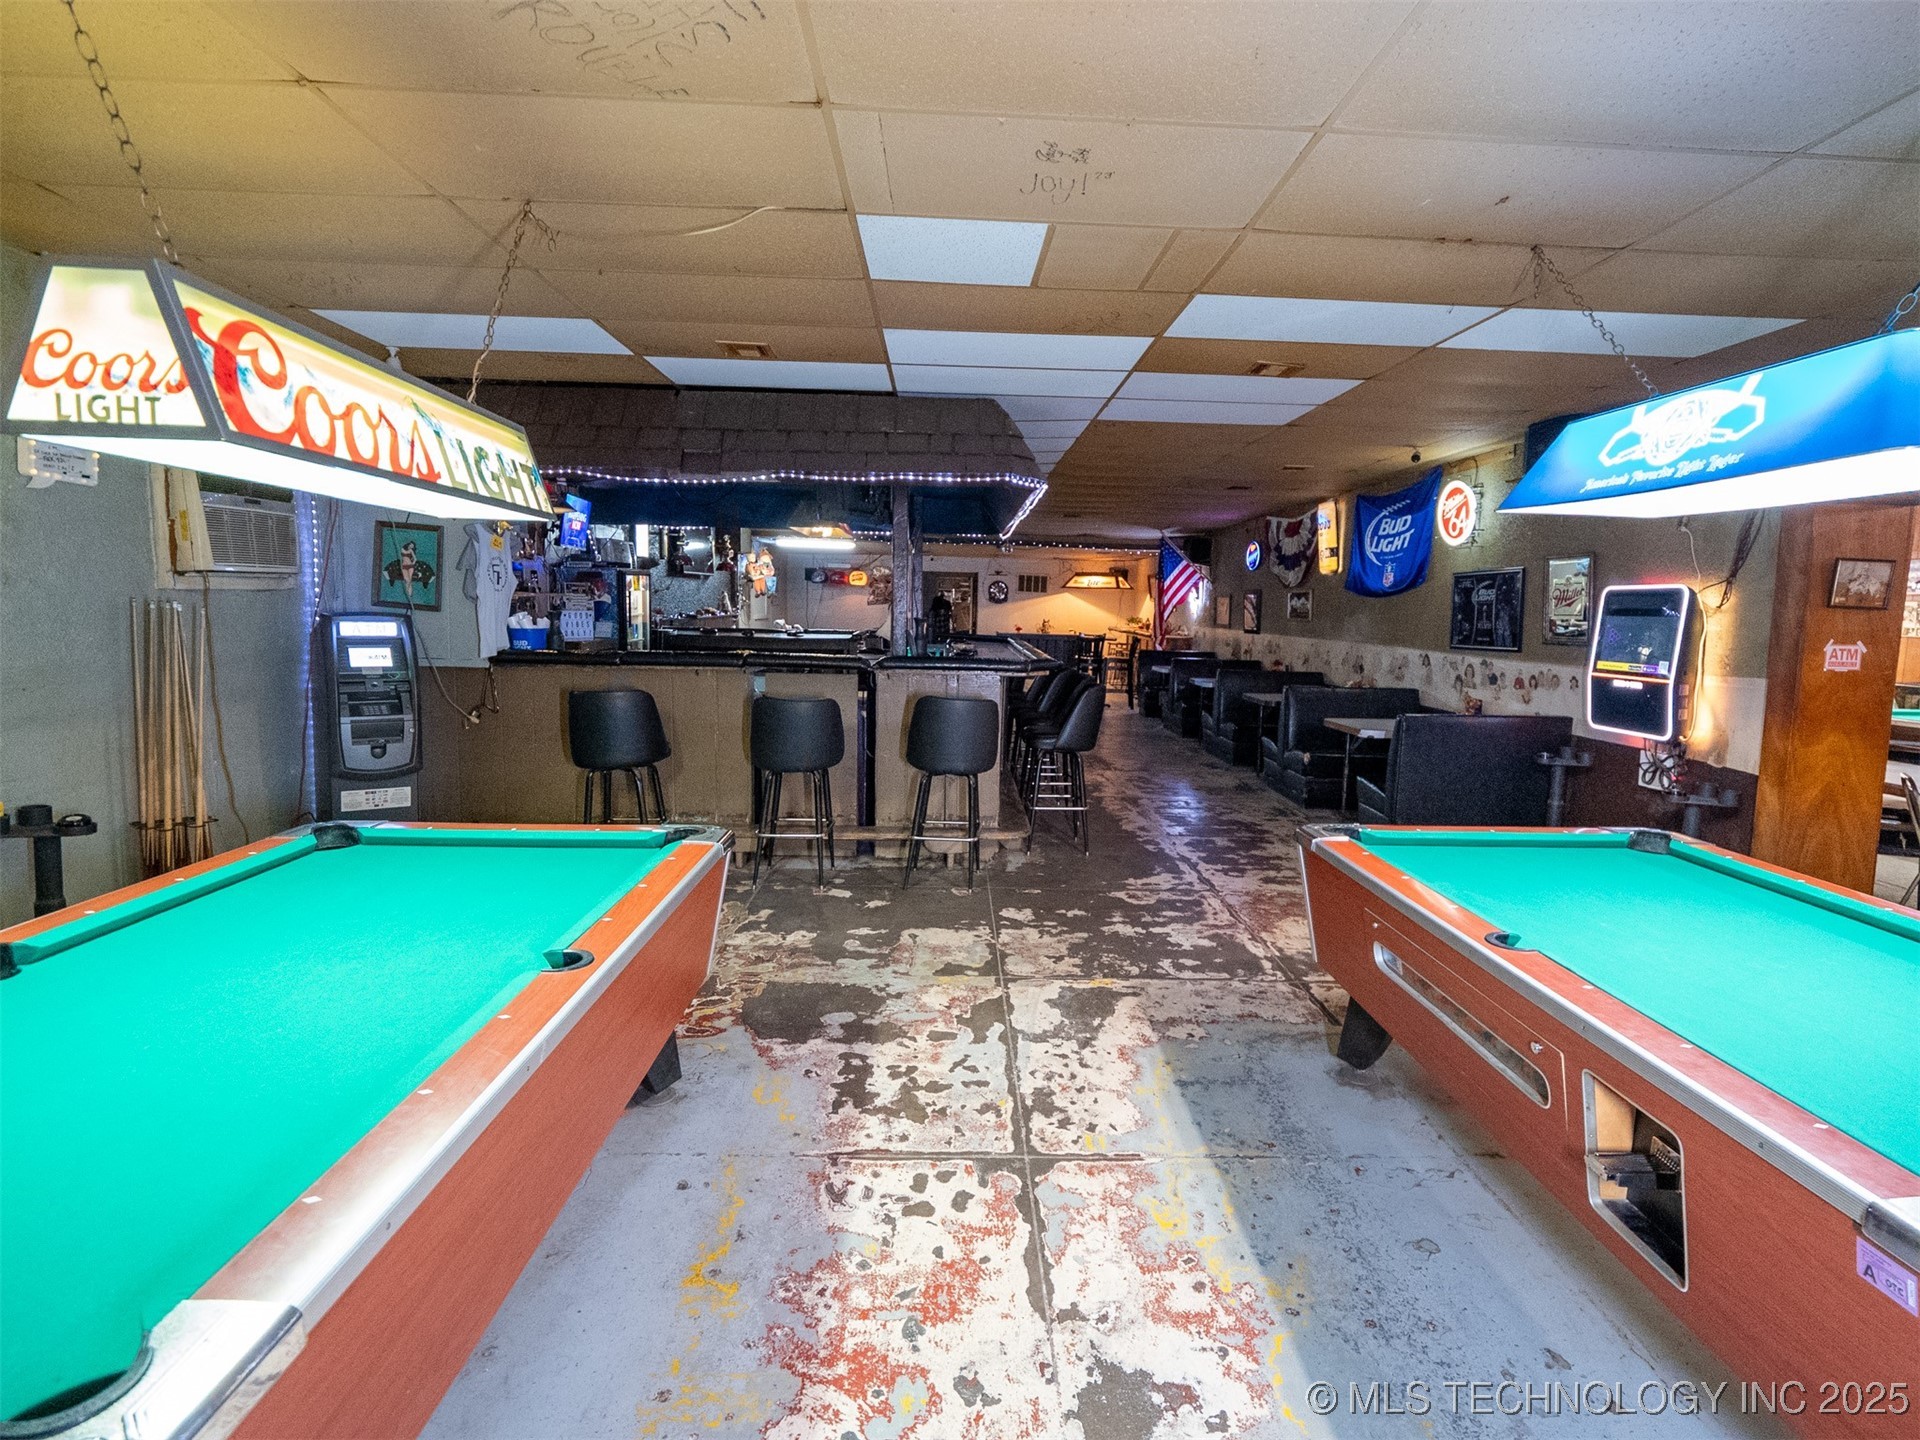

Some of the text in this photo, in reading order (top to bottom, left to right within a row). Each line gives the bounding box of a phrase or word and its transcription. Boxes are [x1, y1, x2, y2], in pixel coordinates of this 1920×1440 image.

[20, 328, 190, 394] Coors
[55, 392, 162, 425] LIGHT
[183, 306, 544, 511] Coors LIGHT
[1378, 515, 1412, 536] BUD
[1447, 504, 1469, 538] 64
[1370, 528, 1415, 553] LIGHT
[1828, 648, 1859, 661] ATM
[1863, 1264, 1877, 1285] A
